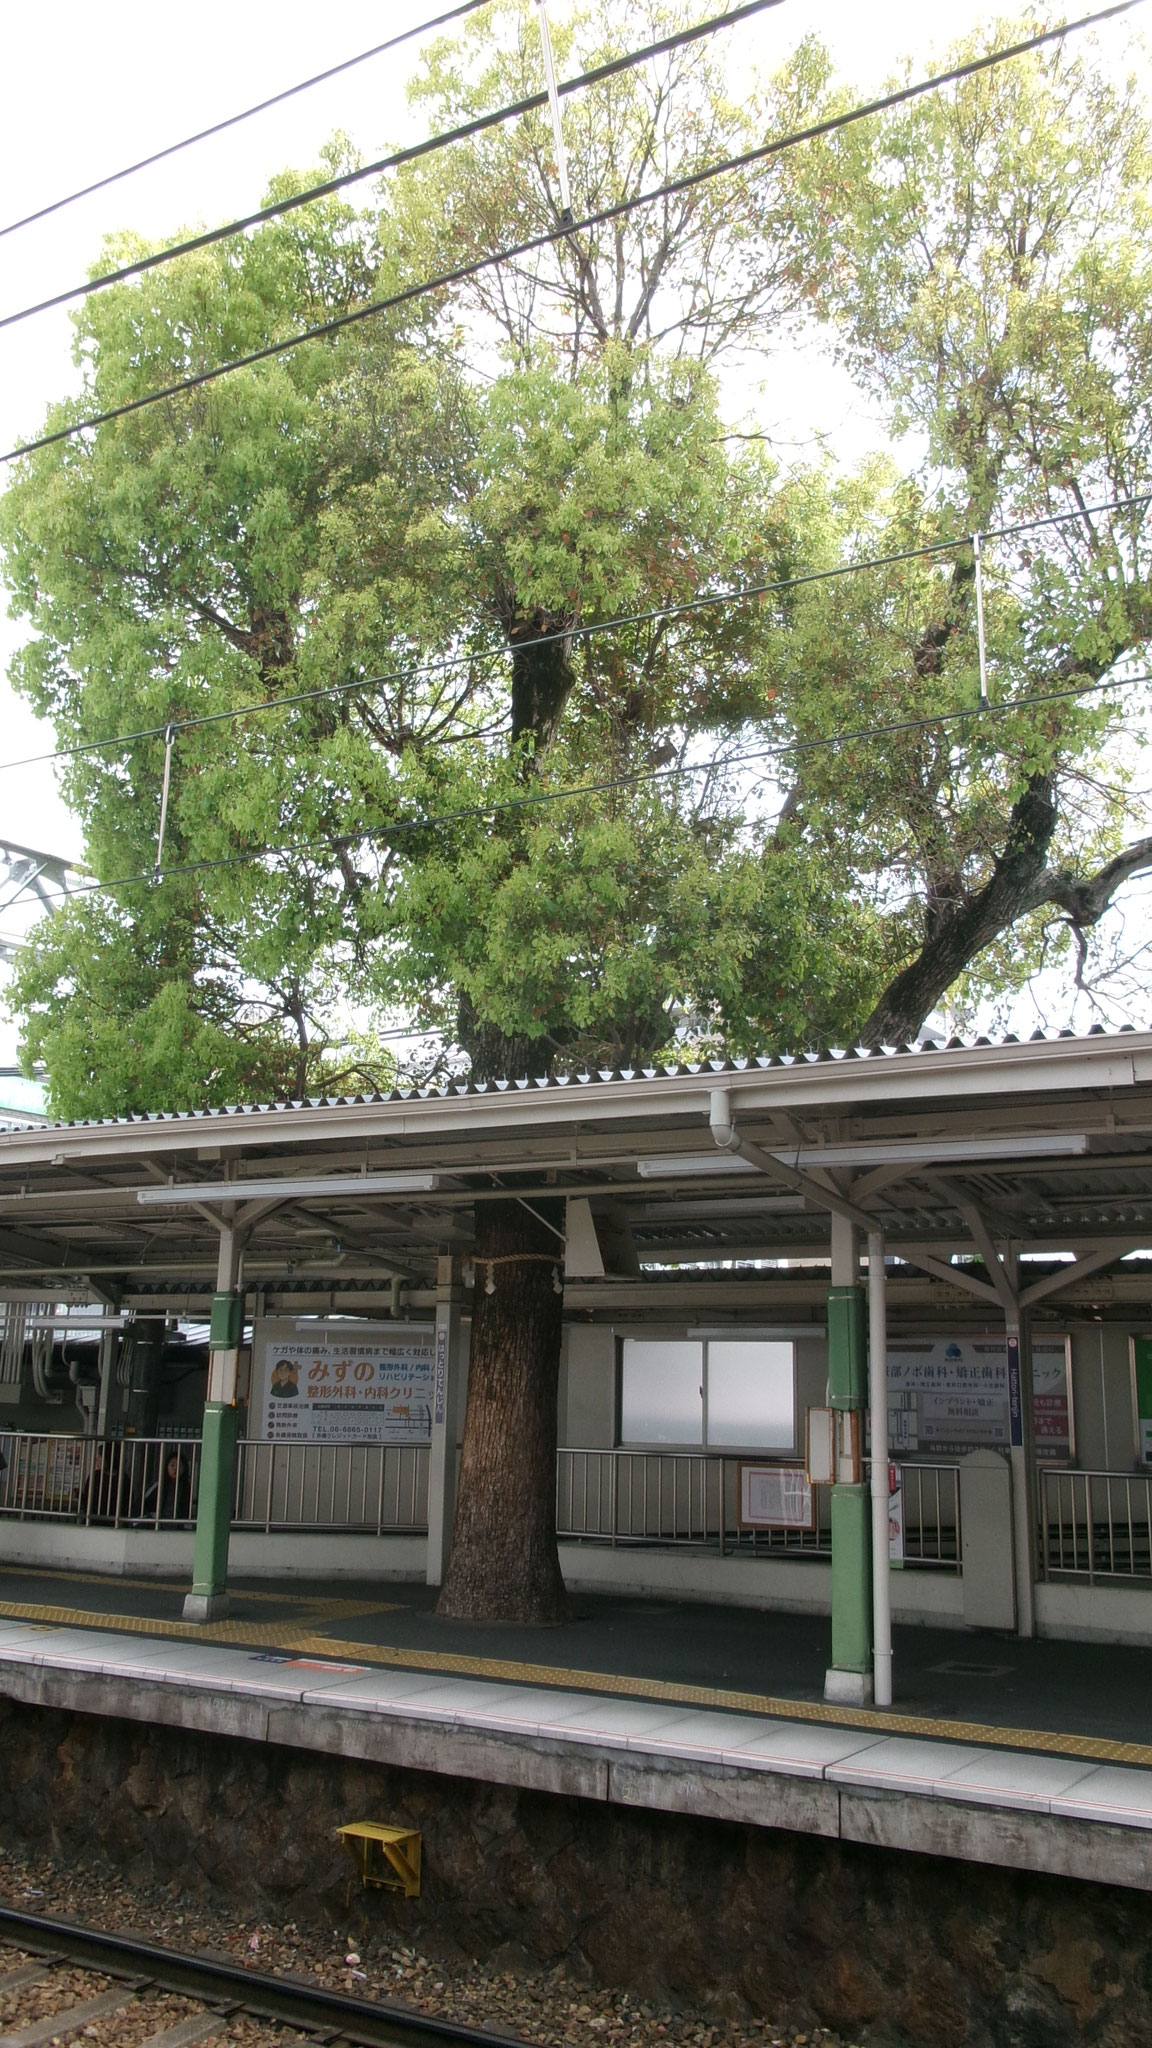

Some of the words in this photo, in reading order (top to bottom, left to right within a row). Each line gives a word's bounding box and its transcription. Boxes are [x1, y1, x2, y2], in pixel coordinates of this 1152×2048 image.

[308, 1359, 375, 1383] みずの
[437, 1345, 445, 1414] はっとりてんじん
[885, 1365, 1006, 1379] 部ノボ歯科・矯正歯科
